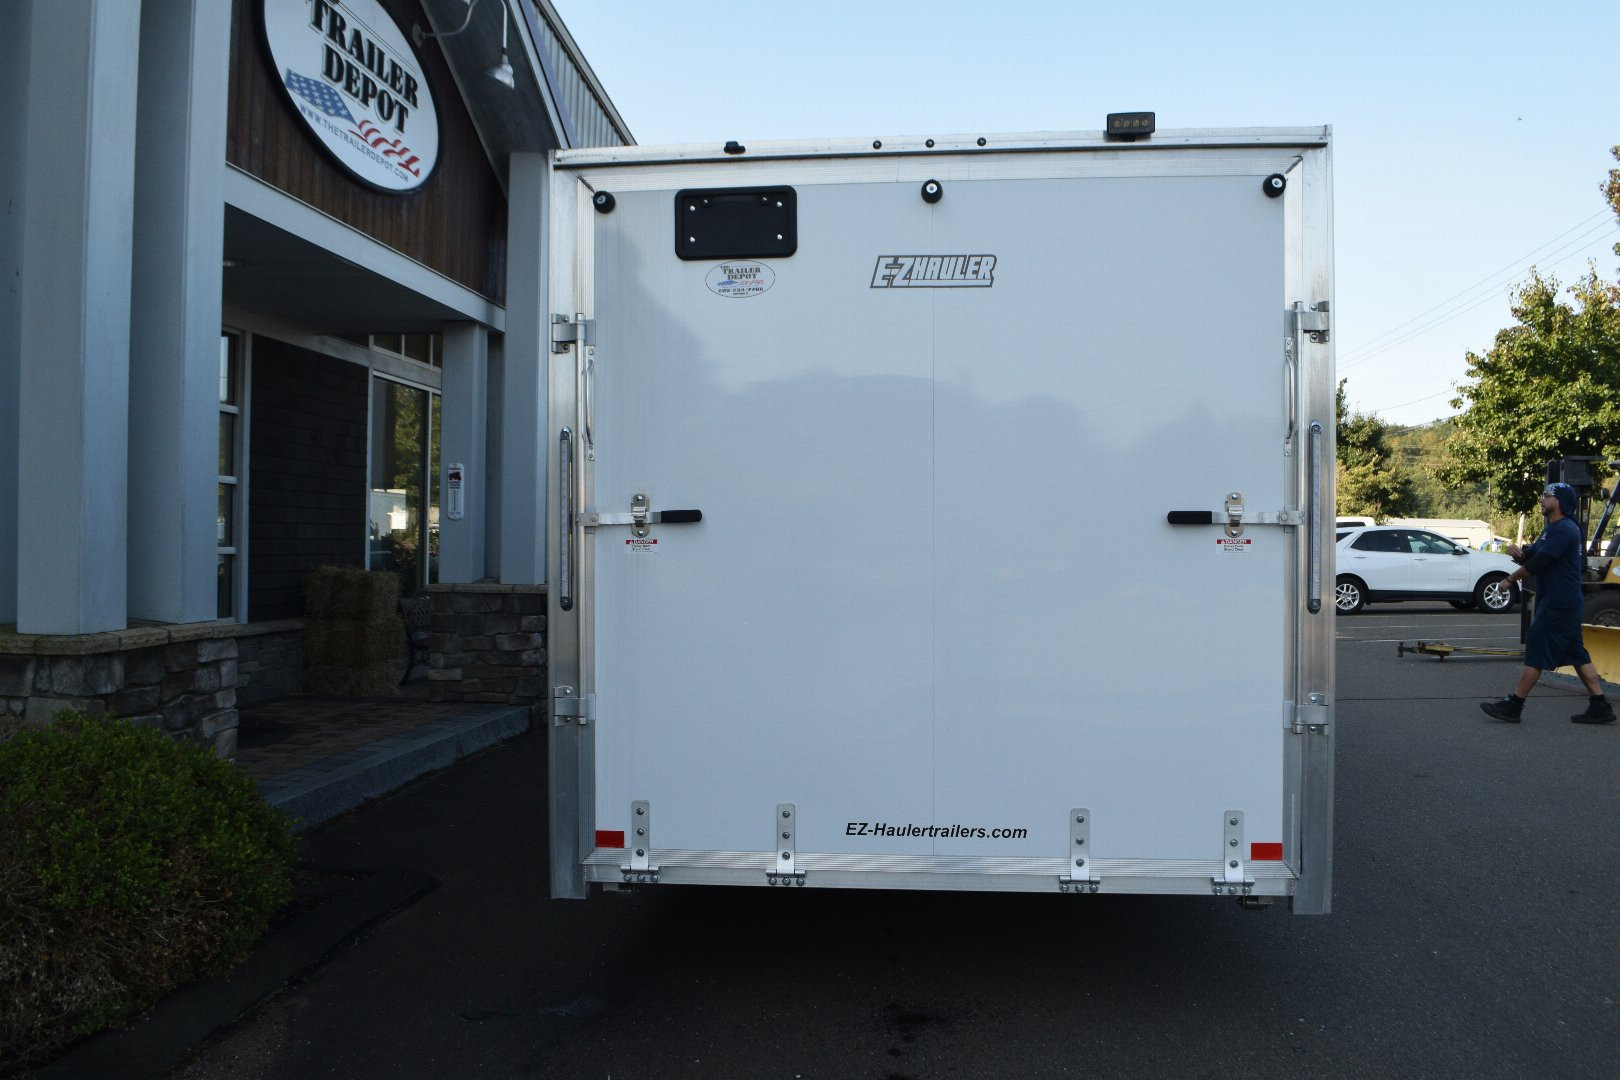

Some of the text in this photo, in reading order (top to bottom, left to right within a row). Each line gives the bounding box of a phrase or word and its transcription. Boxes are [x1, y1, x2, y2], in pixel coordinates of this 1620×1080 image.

[306, 0, 418, 110] TRAILER
[321, 43, 408, 135] DEPOT
[299, 102, 409, 183] WWW.THETRAILERDEPOT.COM
[845, 822, 1028, 839] EZ-Haulertrailers.com
